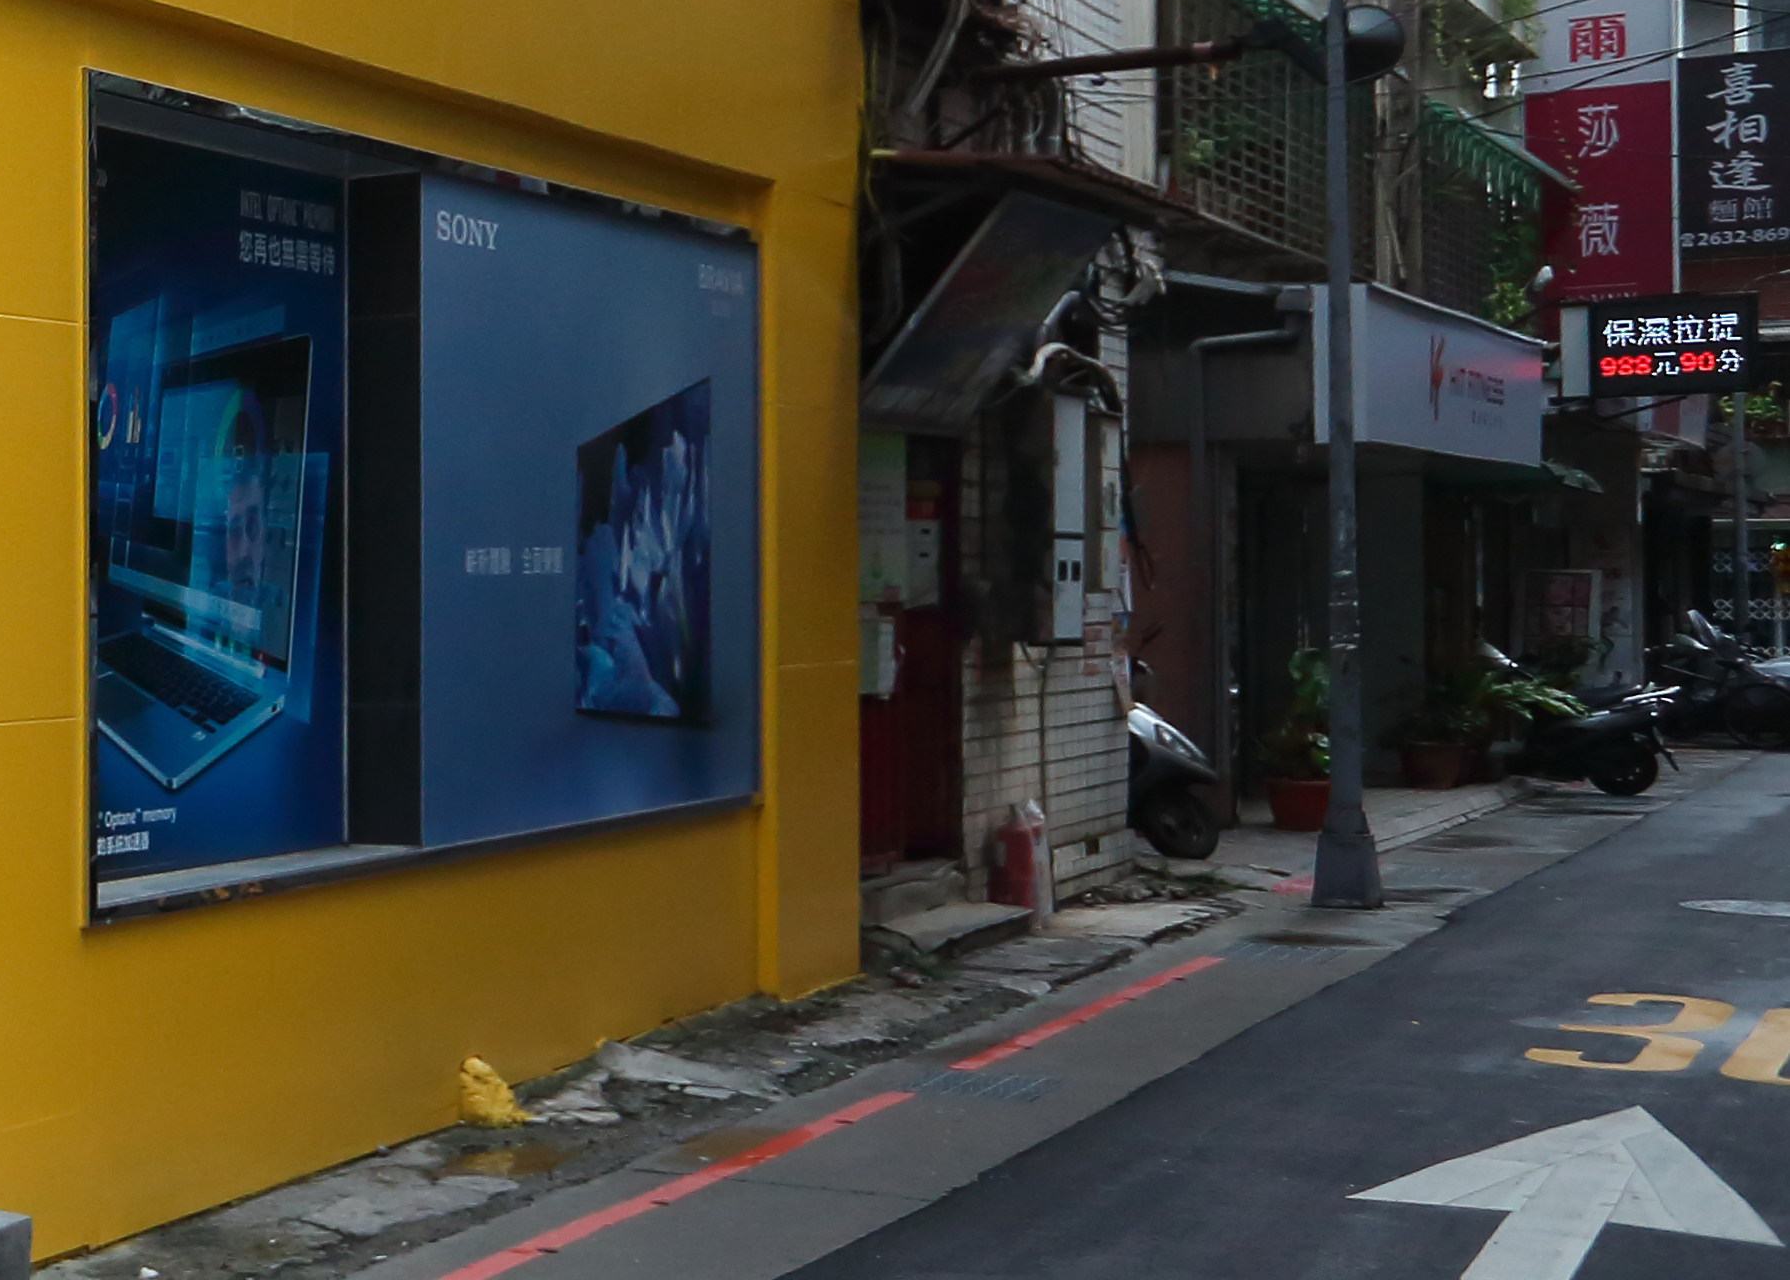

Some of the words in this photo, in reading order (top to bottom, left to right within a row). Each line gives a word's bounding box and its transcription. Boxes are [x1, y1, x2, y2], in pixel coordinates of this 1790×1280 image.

[1577, 102, 1621, 258] 莎薇
[435, 209, 501, 252] SONY
[1602, 312, 1744, 347] 保濕拉提
[1599, 348, 1746, 377] 988元90分
